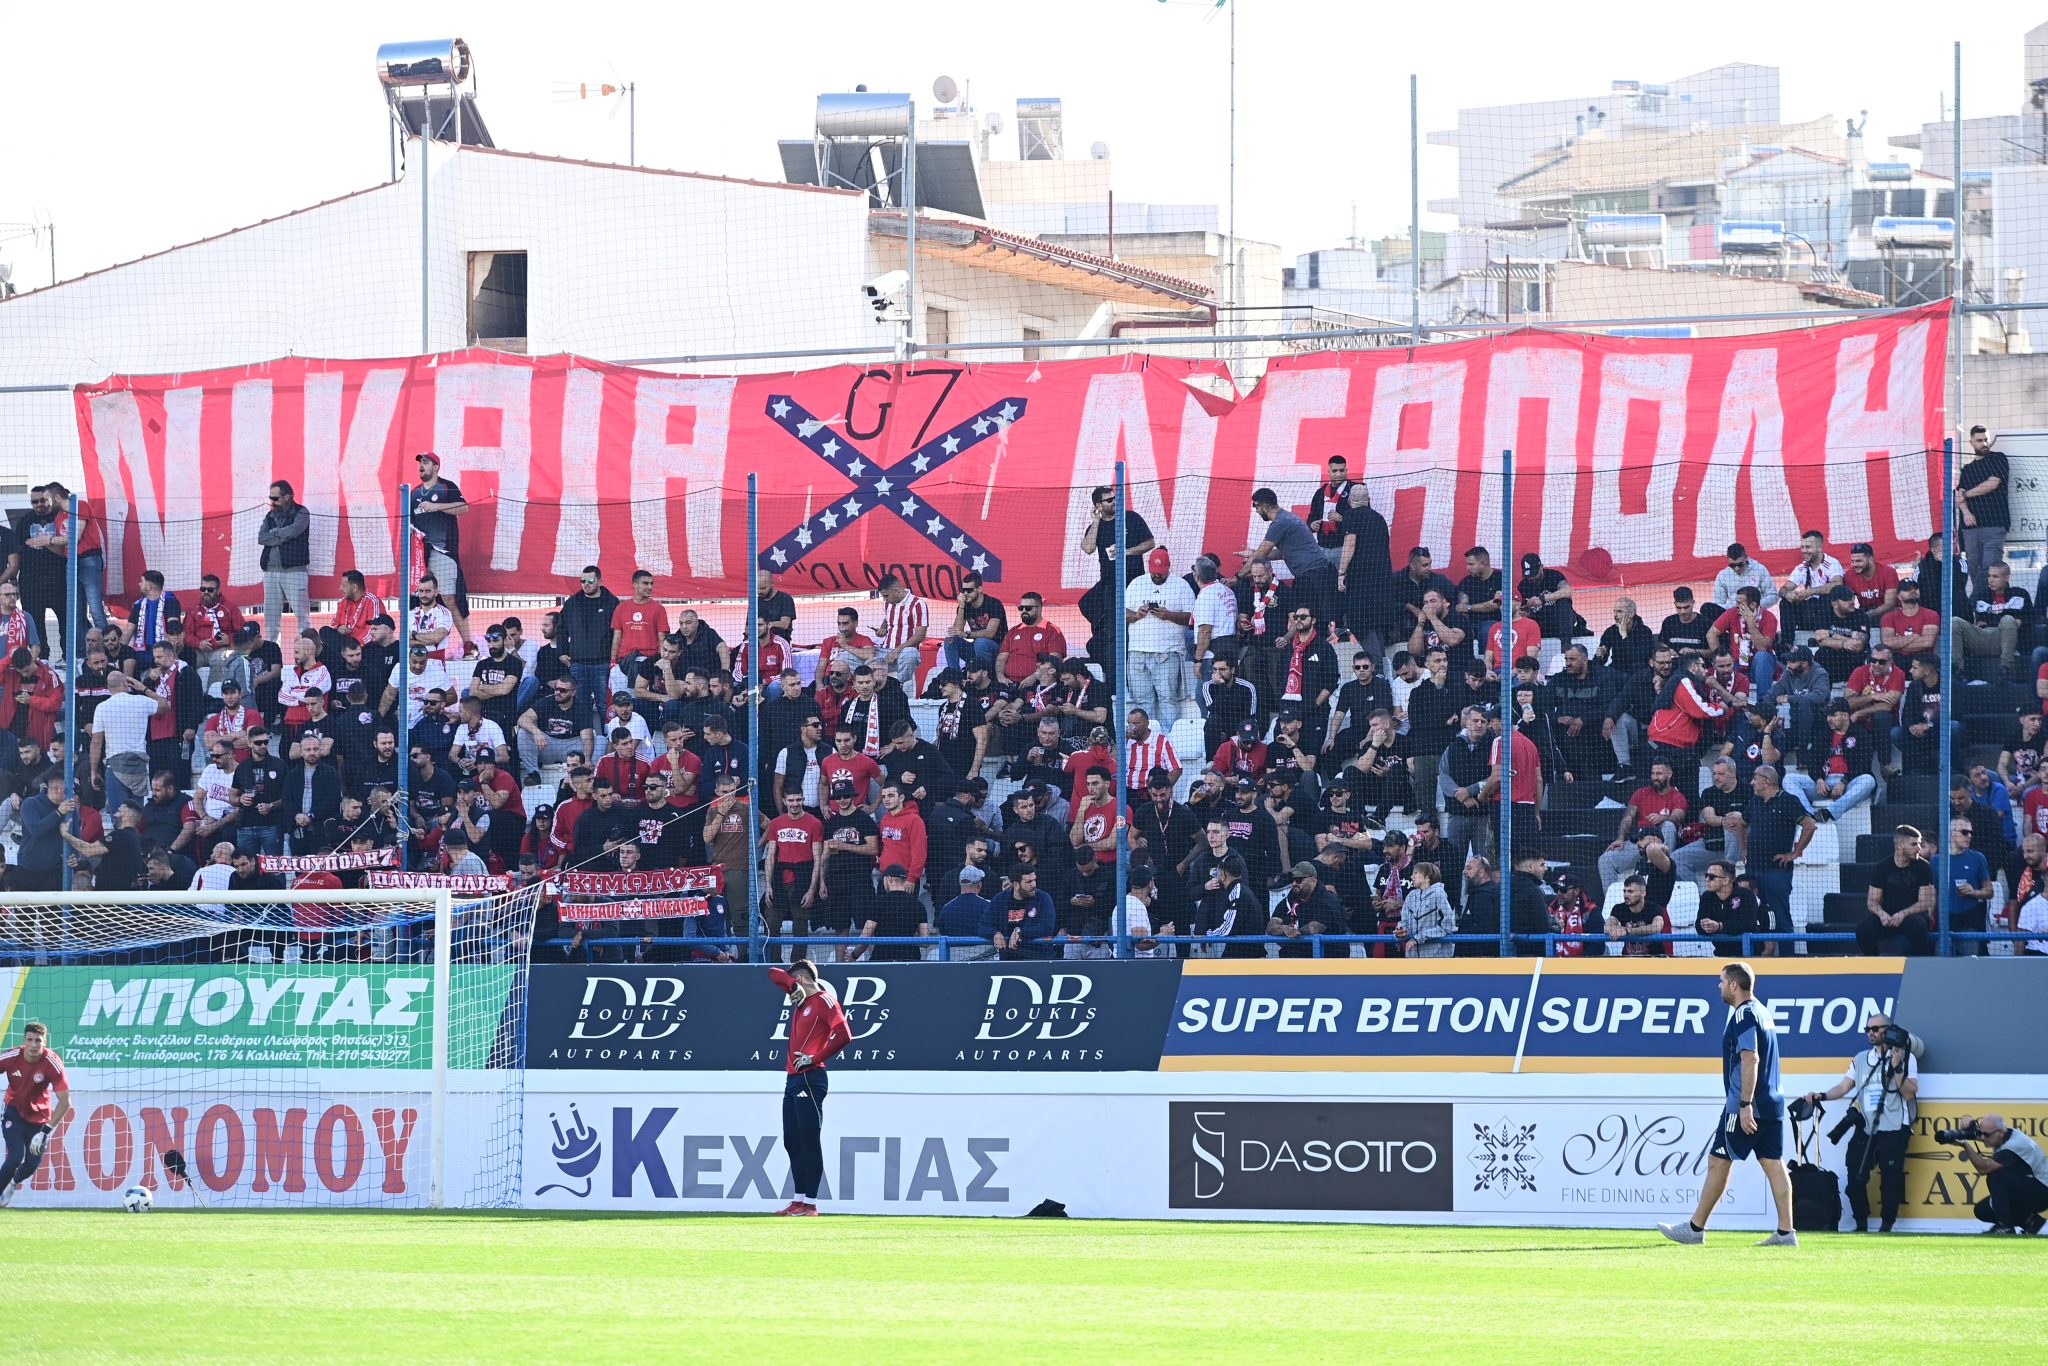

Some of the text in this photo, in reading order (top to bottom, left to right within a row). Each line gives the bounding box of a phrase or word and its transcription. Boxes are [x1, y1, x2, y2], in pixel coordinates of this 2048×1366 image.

[90, 320, 1930, 595] ΝΙΚΑΙΑ ΝΕΑΠΟΛΗ
[566, 899, 699, 919] BRIGADE GLYFADA
[78, 977, 430, 1027] ΜΠΟΥΤΑΣ
[577, 1008, 688, 1022] BOUKIS
[780, 1008, 890, 1021] BKIS
[983, 1007, 1097, 1021] BOUKIS
[1177, 997, 1521, 1034] SUPER BETON
[1537, 997, 1894, 1035] SUPER ETON
[69, 1034, 130, 1047] Λεωφόρος
[132, 1034, 191, 1047] Βενιζέλου
[193, 1034, 261, 1048] Ελευθέριου
[207, 1049, 227, 1060] 176
[230, 1049, 243, 1060] 74
[336, 1050, 357, 1061] 210
[548, 1048, 694, 1061] AUTOPARTS
[750, 1048, 896, 1061] AUARTS
[955, 1048, 1105, 1061] AUTOPARTS
[612, 1106, 1010, 1203] ΚΕΧΓΙΑΣ
[1241, 1140, 1437, 1173] DASOTTO
[1561, 1187, 1735, 1204] FINE DINING & SPIS
